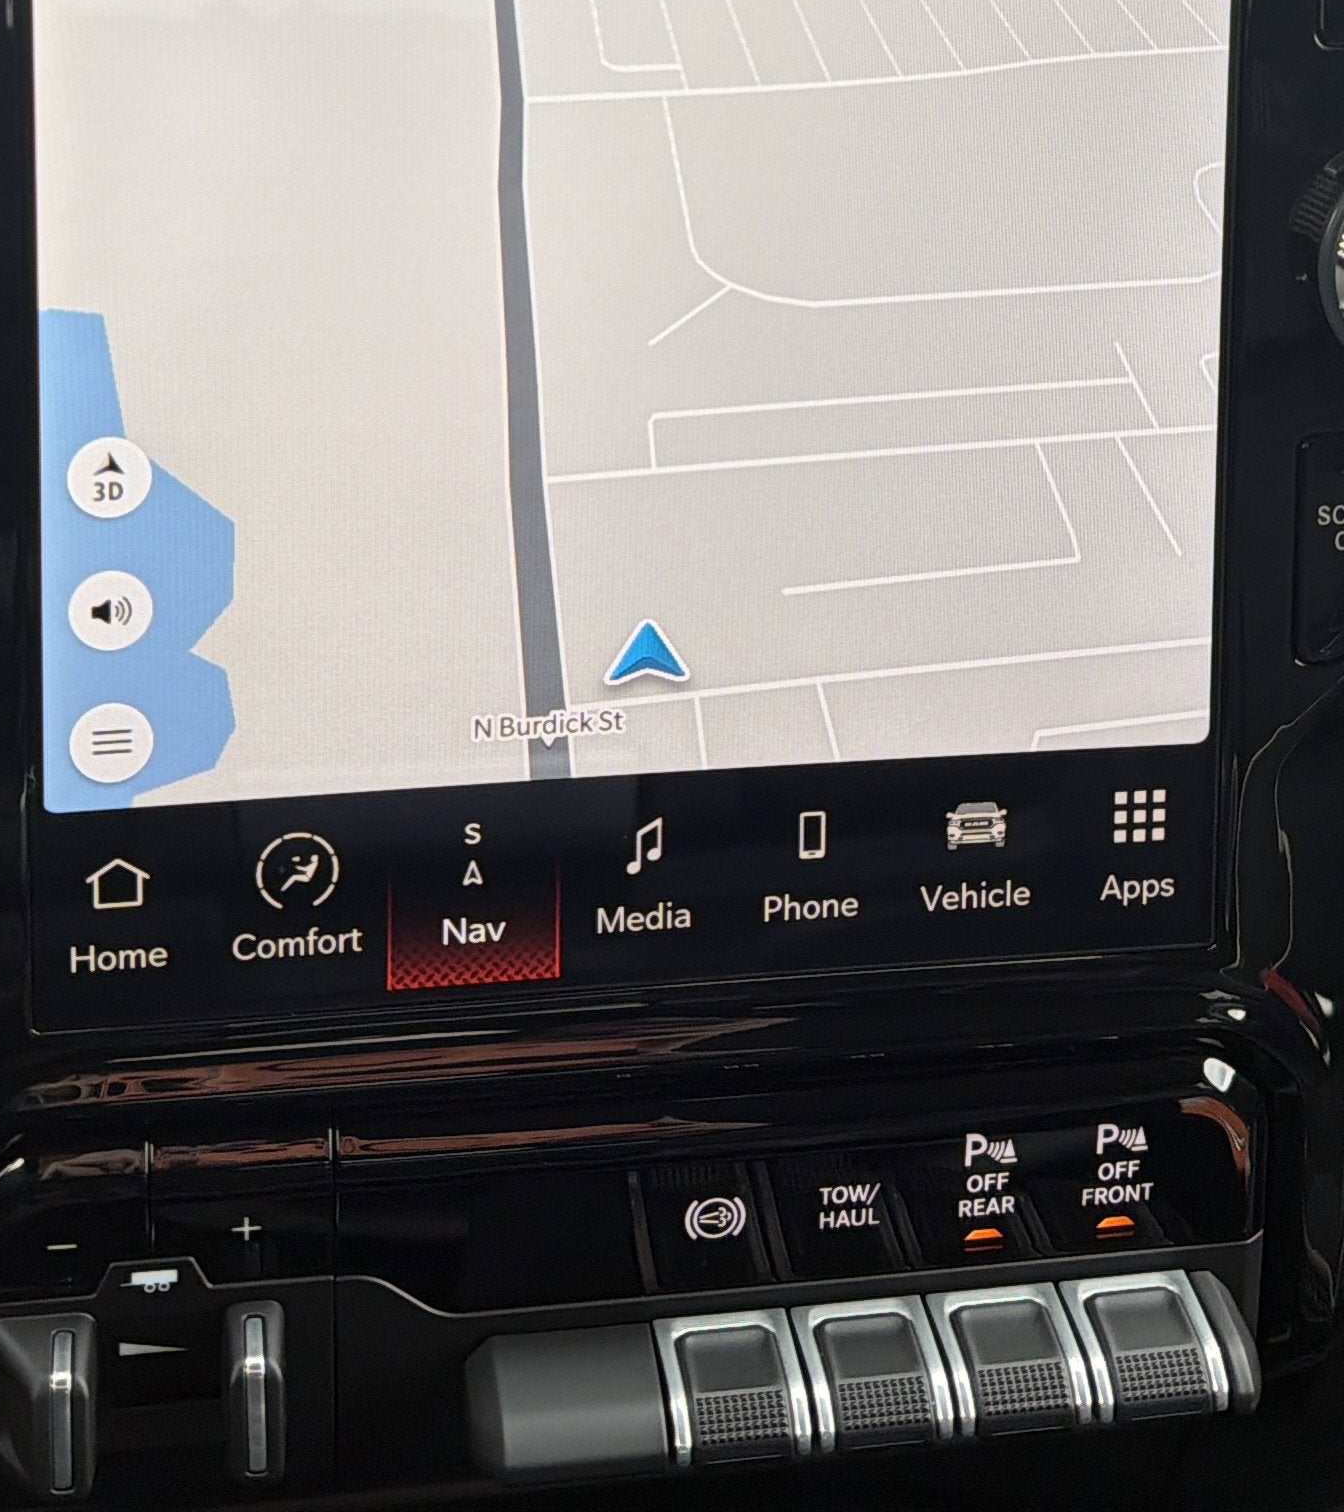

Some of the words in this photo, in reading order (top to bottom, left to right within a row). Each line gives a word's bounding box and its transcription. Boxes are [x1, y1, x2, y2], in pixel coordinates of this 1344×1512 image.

[93, 481, 124, 502] 3D
[474, 718, 492, 739] N
[499, 711, 593, 738] Burdick
[598, 710, 624, 732] St
[464, 822, 482, 845] S
[920, 879, 1031, 912] Vehicle
[1099, 874, 1175, 907] Apps
[597, 901, 691, 934] Media
[764, 893, 859, 923] Phone
[232, 926, 363, 961] Comfort
[442, 917, 507, 946] Nav
[70, 944, 169, 974] Home
[964, 1133, 988, 1167] P
[1095, 1123, 1120, 1155] P
[966, 1171, 1010, 1193] OFF
[1097, 1159, 1141, 1182] OFF
[819, 1182, 881, 1206] TOW/
[958, 1195, 1015, 1218] REAR
[1081, 1182, 1154, 1206] FRONT
[819, 1207, 880, 1230] HAUL
